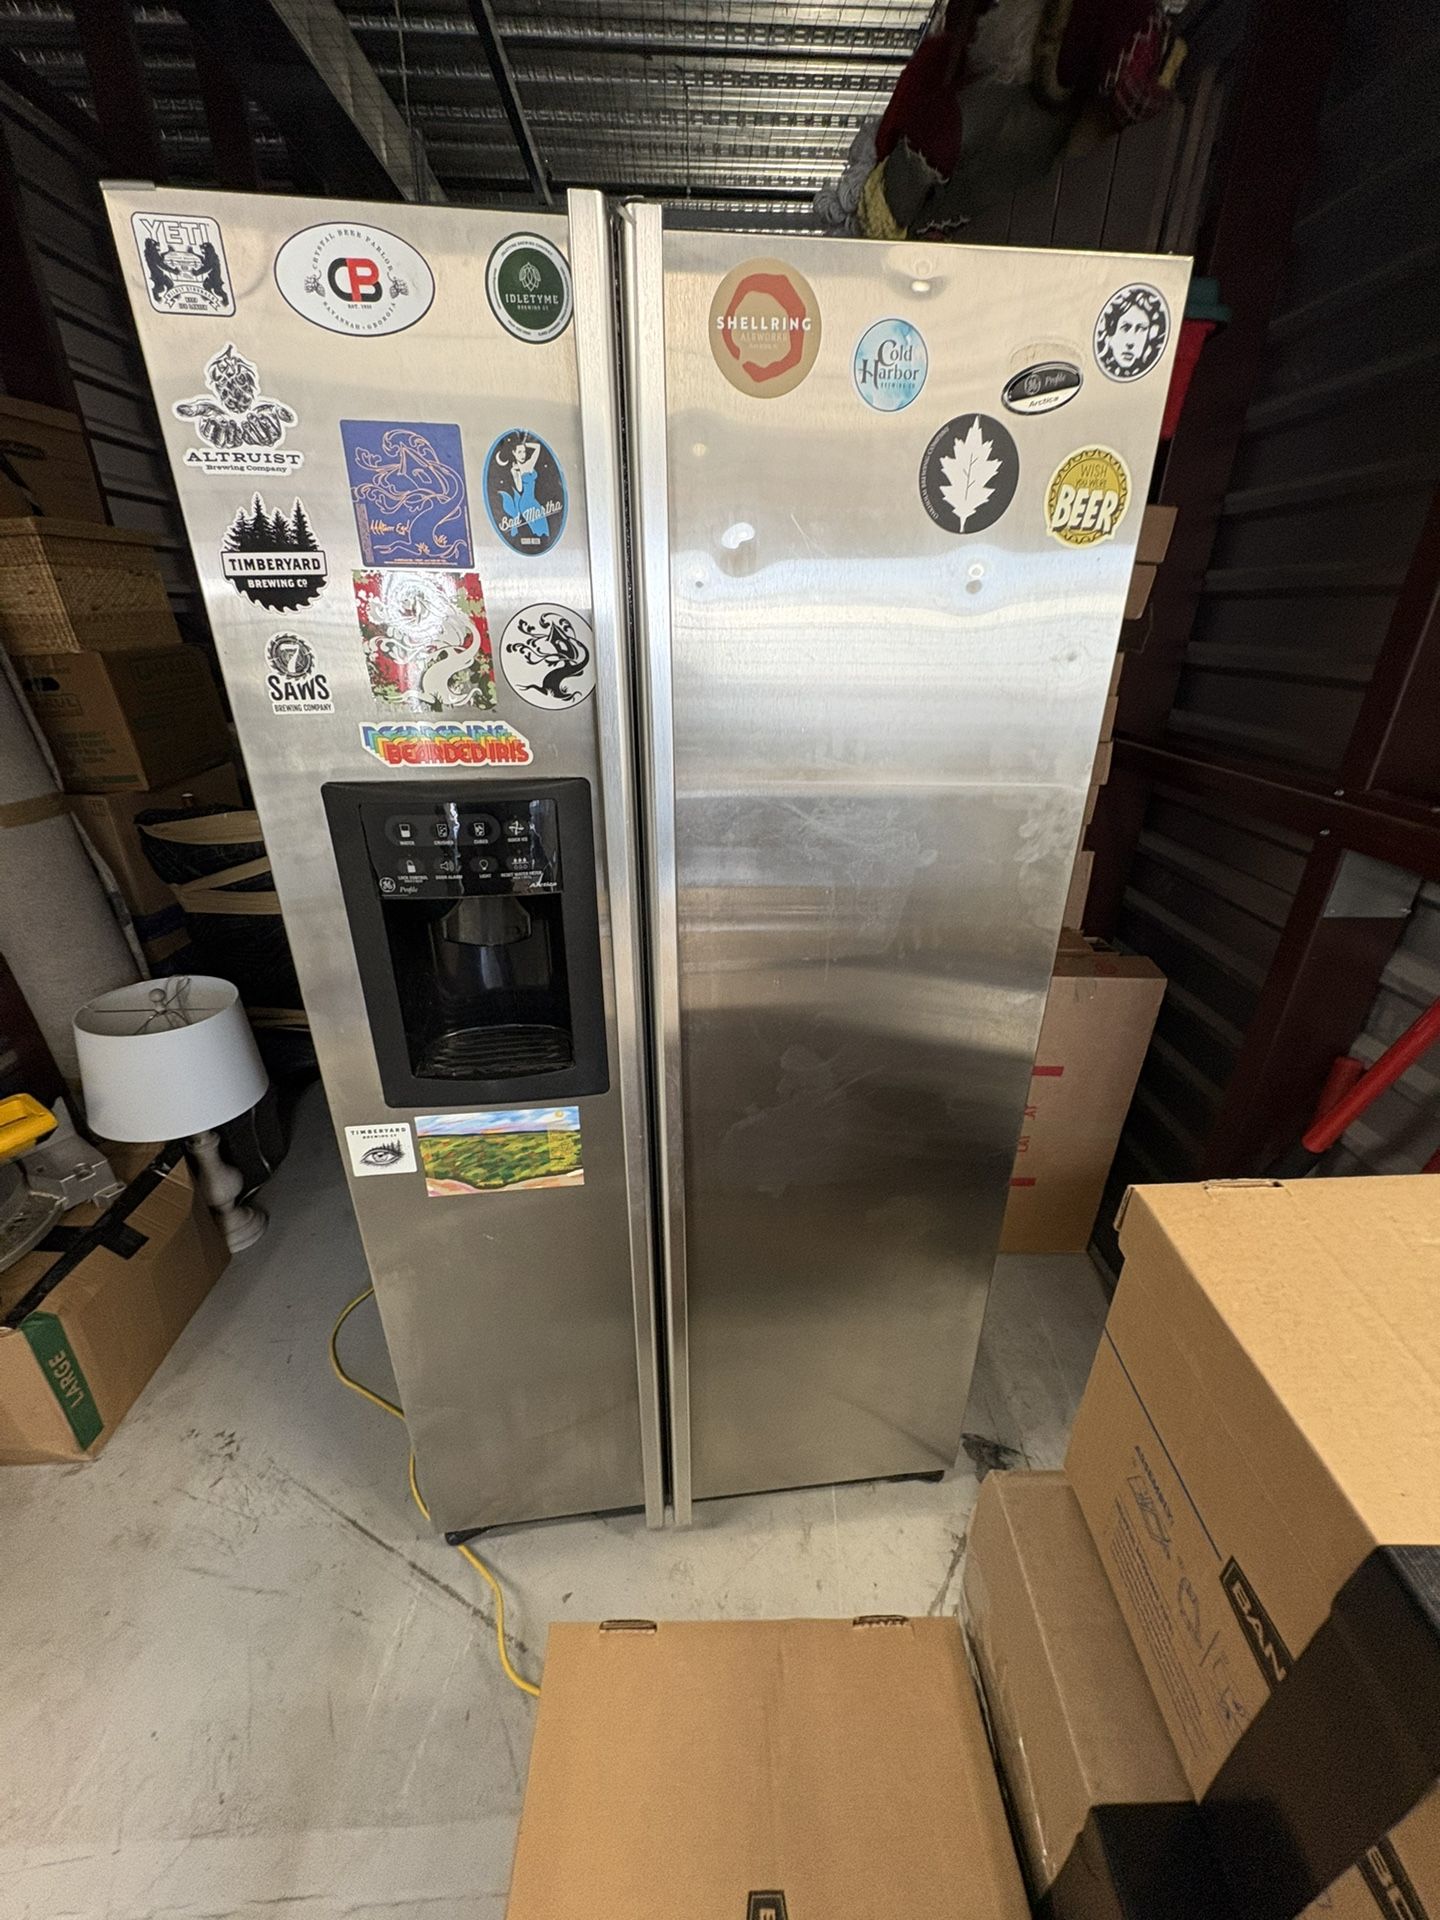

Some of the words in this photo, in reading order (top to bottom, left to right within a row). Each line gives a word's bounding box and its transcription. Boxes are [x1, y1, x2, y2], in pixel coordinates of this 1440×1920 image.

[140, 218, 210, 245] YETI
[312, 233, 335, 270] CRYSTAL
[337, 229, 362, 238] BEER
[364, 236, 394, 272] PARLOR
[505, 293, 559, 304] IDLETYME
[367, 302, 397, 330] GEORGIA
[716, 316, 812, 331] SHELLRING
[877, 339, 913, 367] Cold
[858, 359, 920, 390] Harbor
[187, 452, 301, 465] ALTRUIST
[206, 464, 245, 472] Brewing
[246, 465, 287, 473] Company
[1081, 463, 1108, 478] WISH
[498, 512, 522, 531] Bad
[522, 500, 563, 522] Martha
[1051, 484, 1119, 534] BEER
[228, 558, 321, 571] TIMBERYARD
[247, 579, 295, 588] BREWING
[279, 643, 300, 673] 7
[267, 674, 330, 701] SAWS
[274, 704, 302, 712] BREWING
[303, 703, 332, 712] COMPANY
[383, 740, 487, 765] BEARDED
[488, 741, 530, 764] IRIS
[48, 1350, 85, 1409] LARGE
